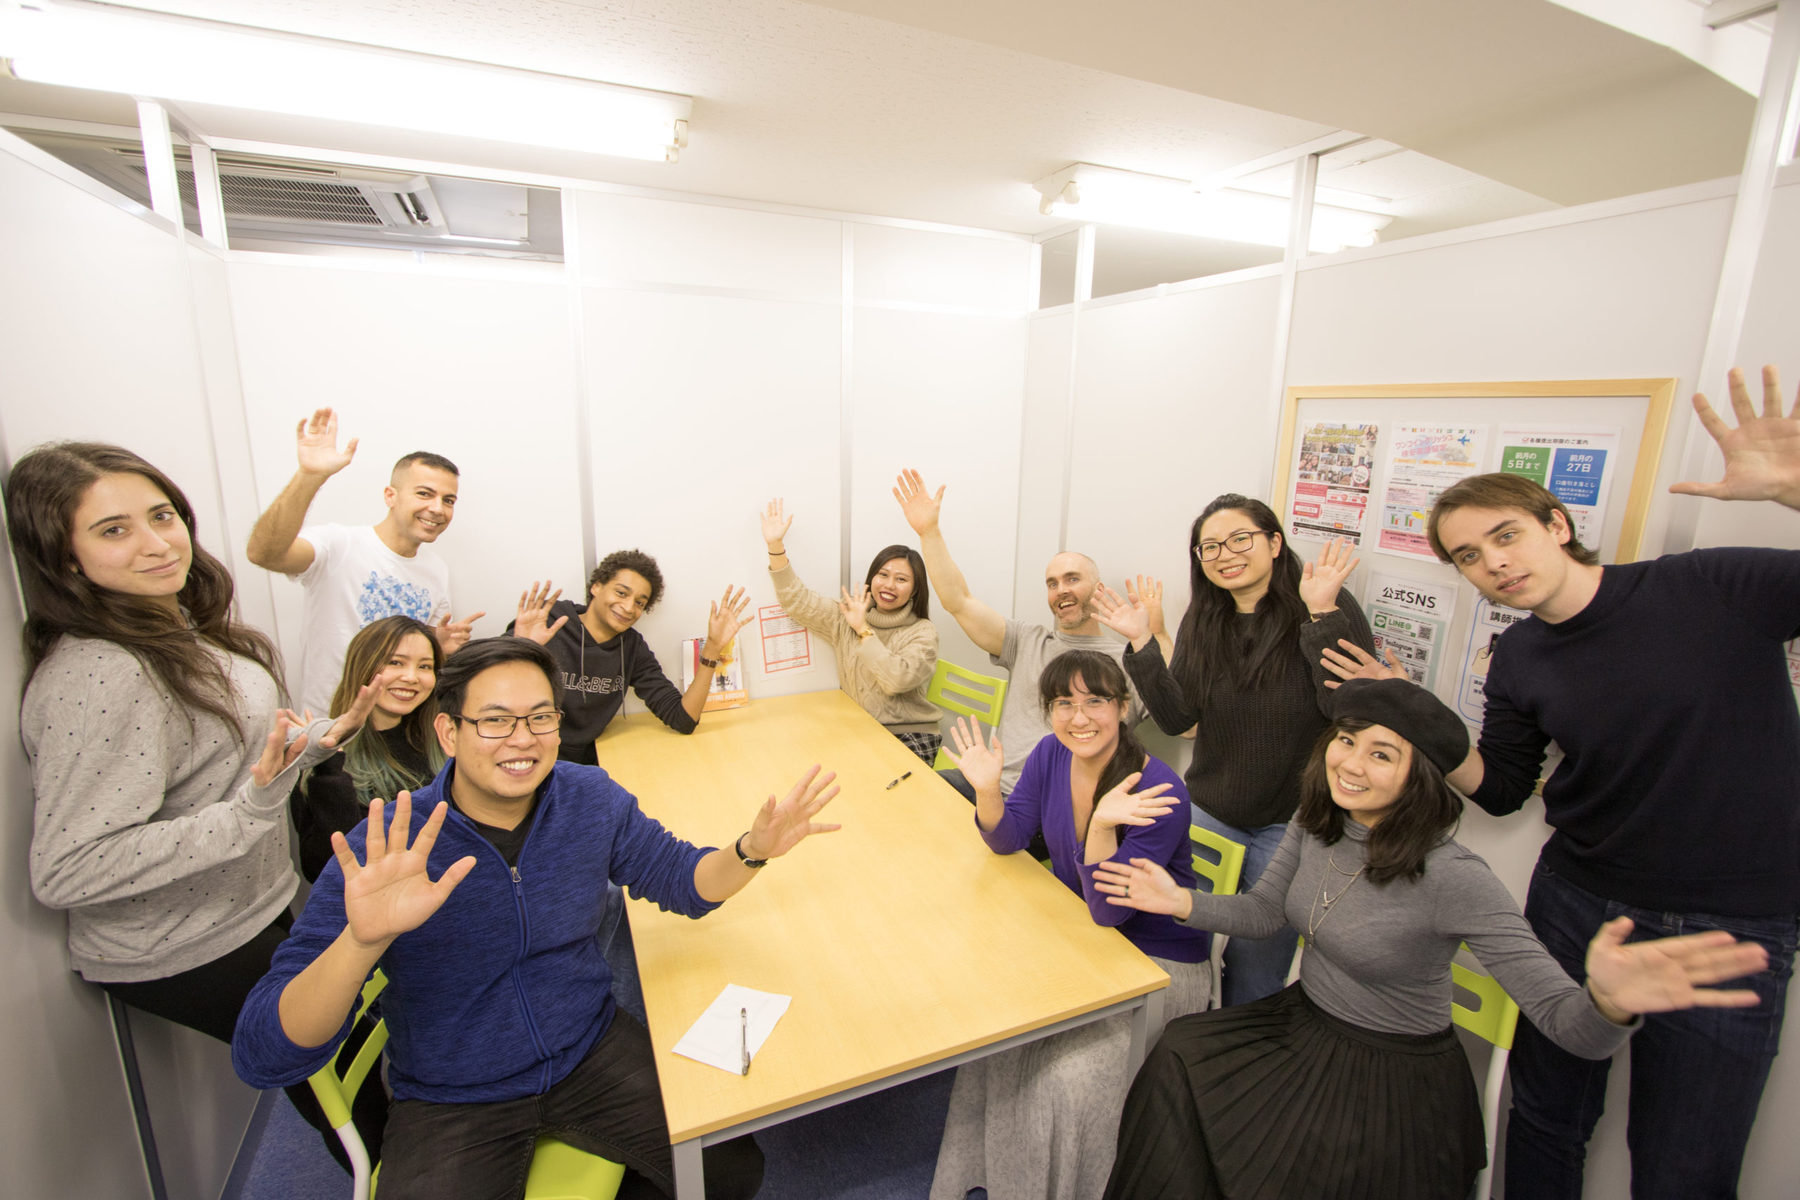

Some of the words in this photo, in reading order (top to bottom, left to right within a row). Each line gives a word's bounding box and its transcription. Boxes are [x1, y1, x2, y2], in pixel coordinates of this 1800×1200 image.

[1515, 452, 1537, 460] 前月の
[1569, 454, 1593, 463] 前月の
[1507, 460, 1541, 470] 5日まで
[1566, 463, 1592, 473] 27日
[1382, 586, 1437, 609] 公式SNS
